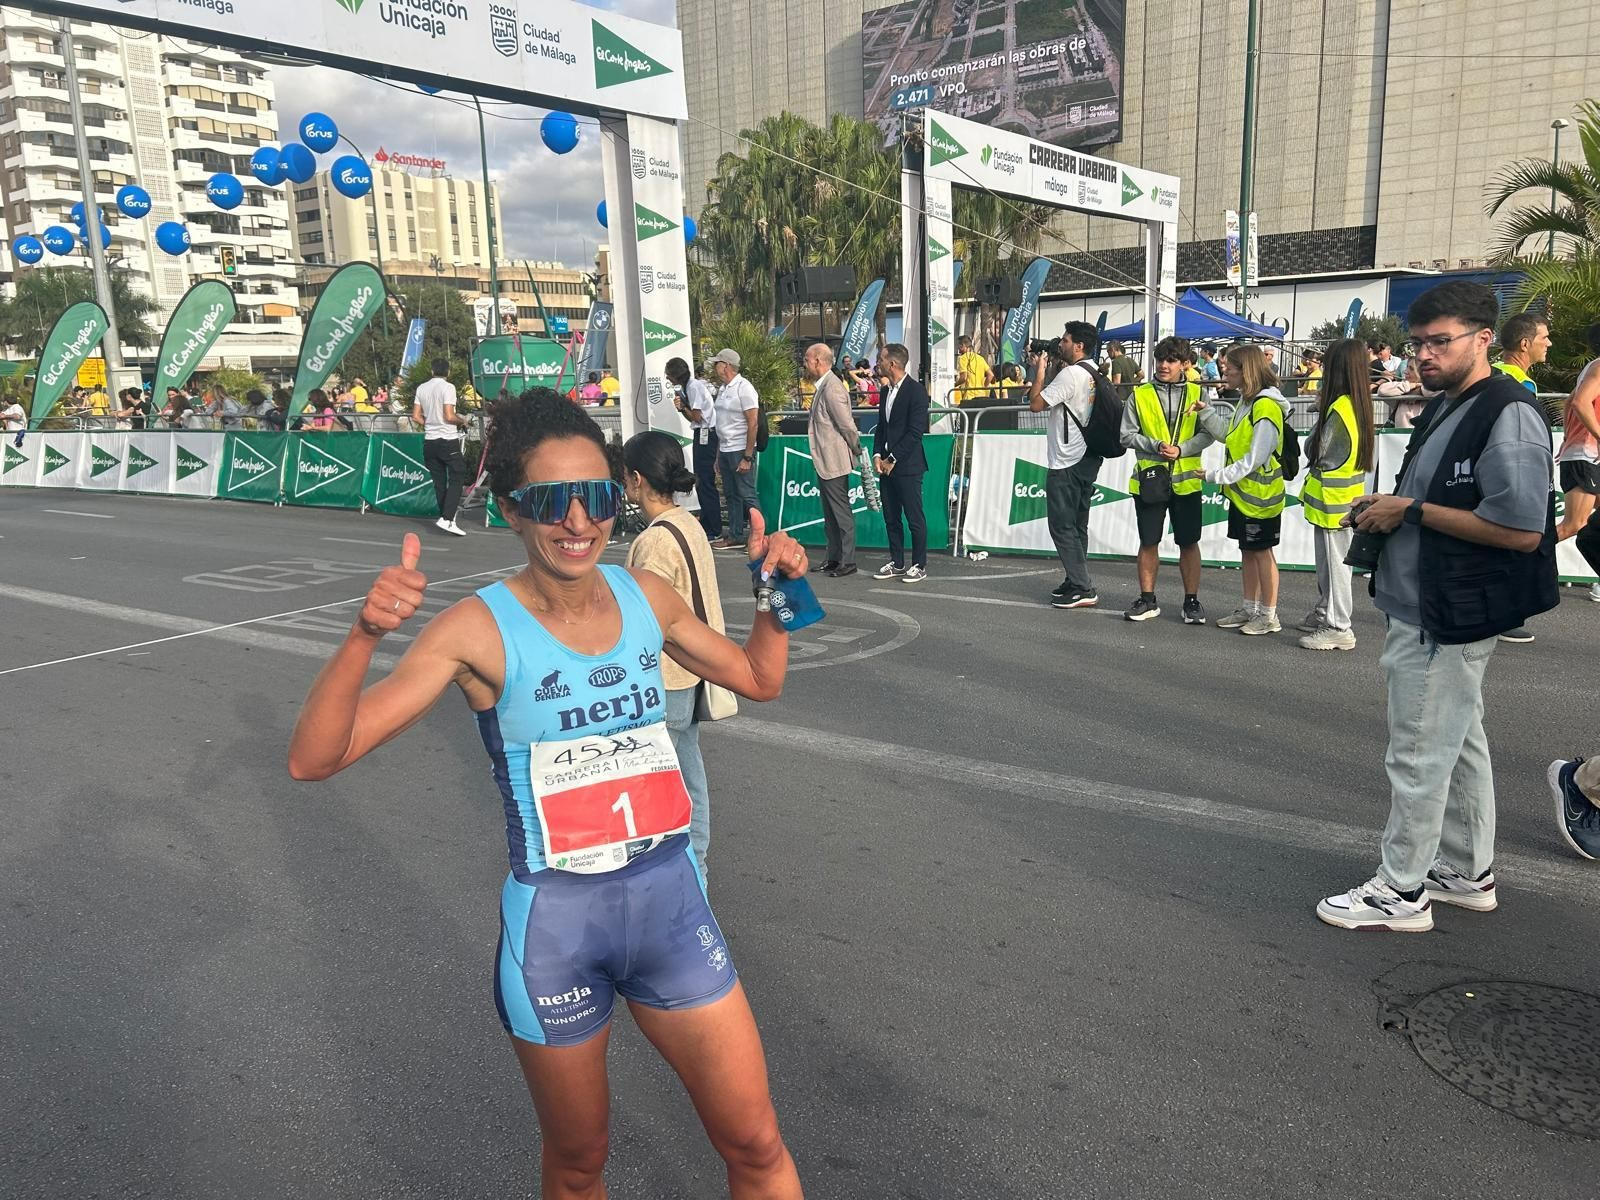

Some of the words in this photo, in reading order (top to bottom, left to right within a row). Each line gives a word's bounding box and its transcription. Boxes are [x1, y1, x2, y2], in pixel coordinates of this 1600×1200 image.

[379, 5, 447, 39] Unicaja
[523, 24, 561, 43] Ciudad
[524, 41, 538, 55] de
[540, 46, 577, 65] Málaga
[890, 71, 928, 87] Pronto
[931, 56, 1006, 78] comenzarán
[1008, 49, 1026, 63] las
[1029, 44, 1065, 60] obras
[1068, 37, 1086, 51] de
[897, 88, 929, 106] 2.471
[939, 82, 968, 98] VPO.
[305, 123, 333, 138] Forus
[391, 152, 447, 169] Santander
[649, 157, 670, 168] Ciudad
[993, 147, 1023, 165] Fundación
[1029, 143, 1077, 174] CARRERA
[1078, 157, 1117, 183] URBANA
[341, 168, 370, 184] Forus
[659, 170, 679, 180] Málaga
[993, 160, 1015, 176] Unicaja
[124, 194, 148, 208] Forus
[19, 243, 41, 255] Forus
[656, 272, 676, 280] Ciudad
[666, 281, 686, 291] Málaga
[1012, 302, 1032, 343] Unicaja
[852, 318, 870, 355] Unicaja
[173, 339, 199, 367] Corte
[317, 328, 346, 363] Corte
[787, 480, 800, 497] El
[1014, 483, 1028, 498] El
[590, 667, 626, 686] TROPS
[534, 683, 570, 697] CUEVA
[557, 684, 661, 732] nerja
[545, 761, 610, 780] CARRERA
[545, 766, 612, 786] URBANA
[651, 764, 678, 773] FEDERADO
[611, 792, 638, 838] 1
[570, 851, 604, 863] Fundación
[570, 858, 596, 868] Unicaja
[536, 986, 592, 1006] nerja
[550, 999, 589, 1014] ATLETISMO
